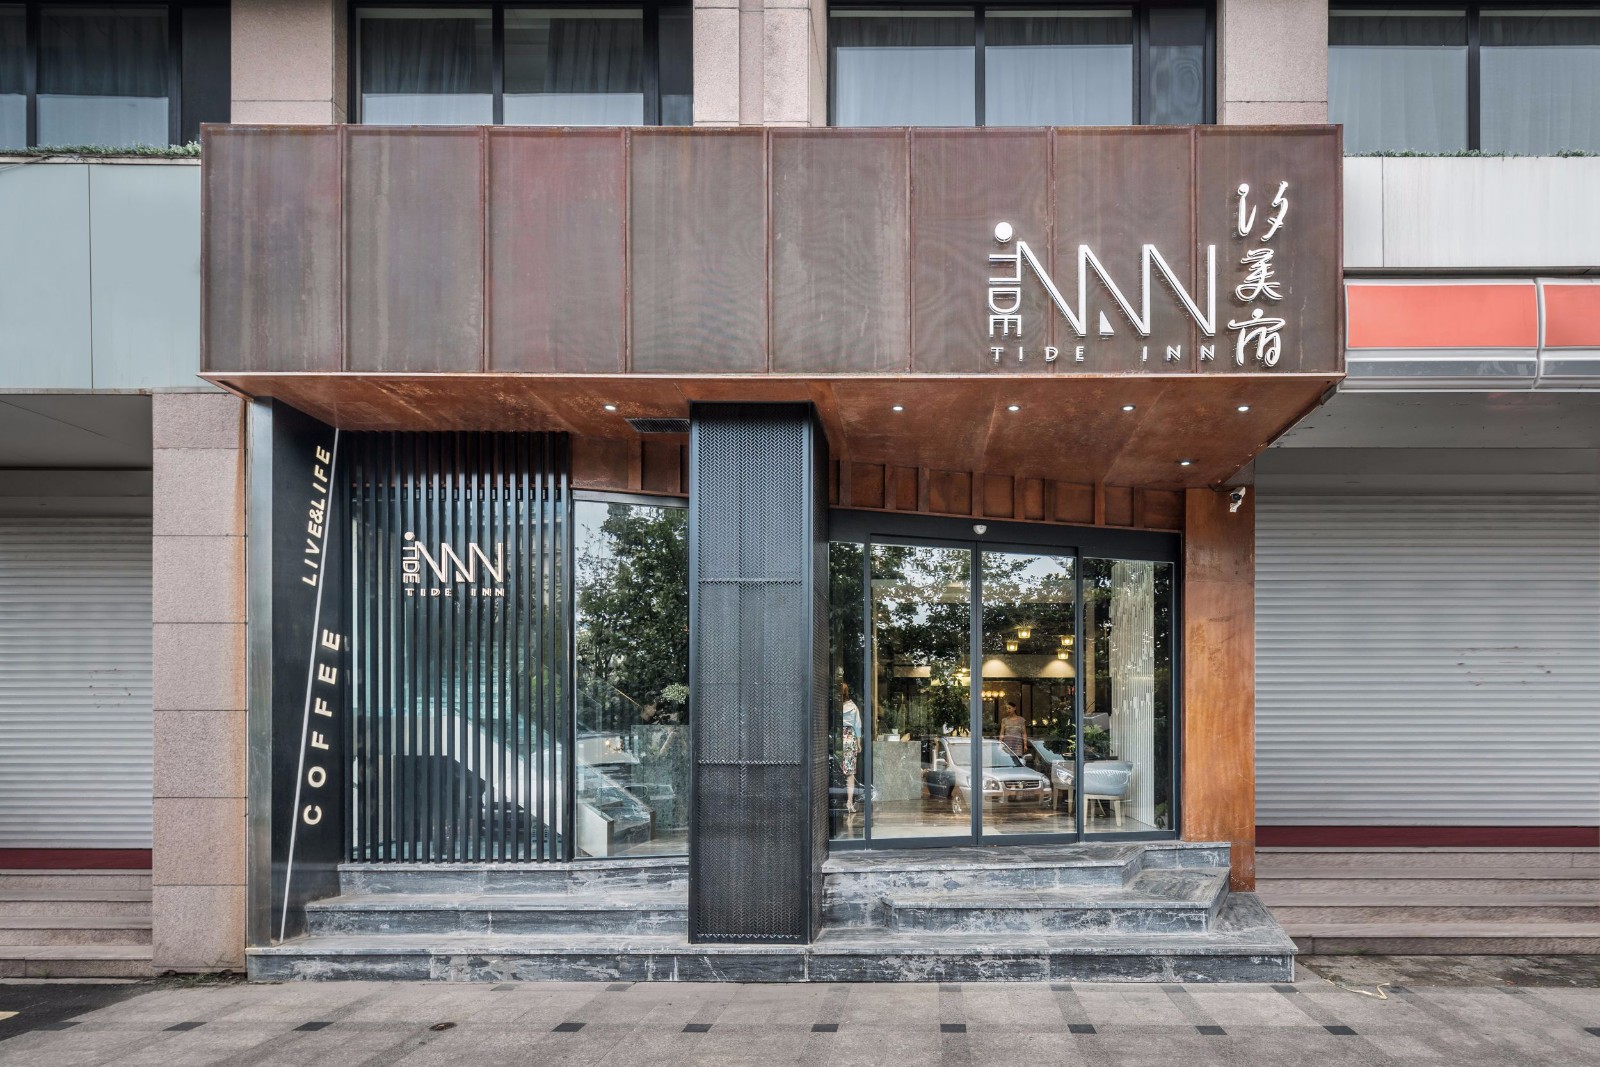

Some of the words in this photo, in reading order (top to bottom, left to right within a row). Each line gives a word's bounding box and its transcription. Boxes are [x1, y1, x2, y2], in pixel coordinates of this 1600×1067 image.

[990, 346, 1084, 362] TIDE
[1142, 345, 1216, 362] INN
[302, 445, 331, 587] LIVE&LIFE
[404, 588, 452, 597] TIDE
[471, 588, 505, 597] INN
[303, 629, 341, 826] COFFEE
